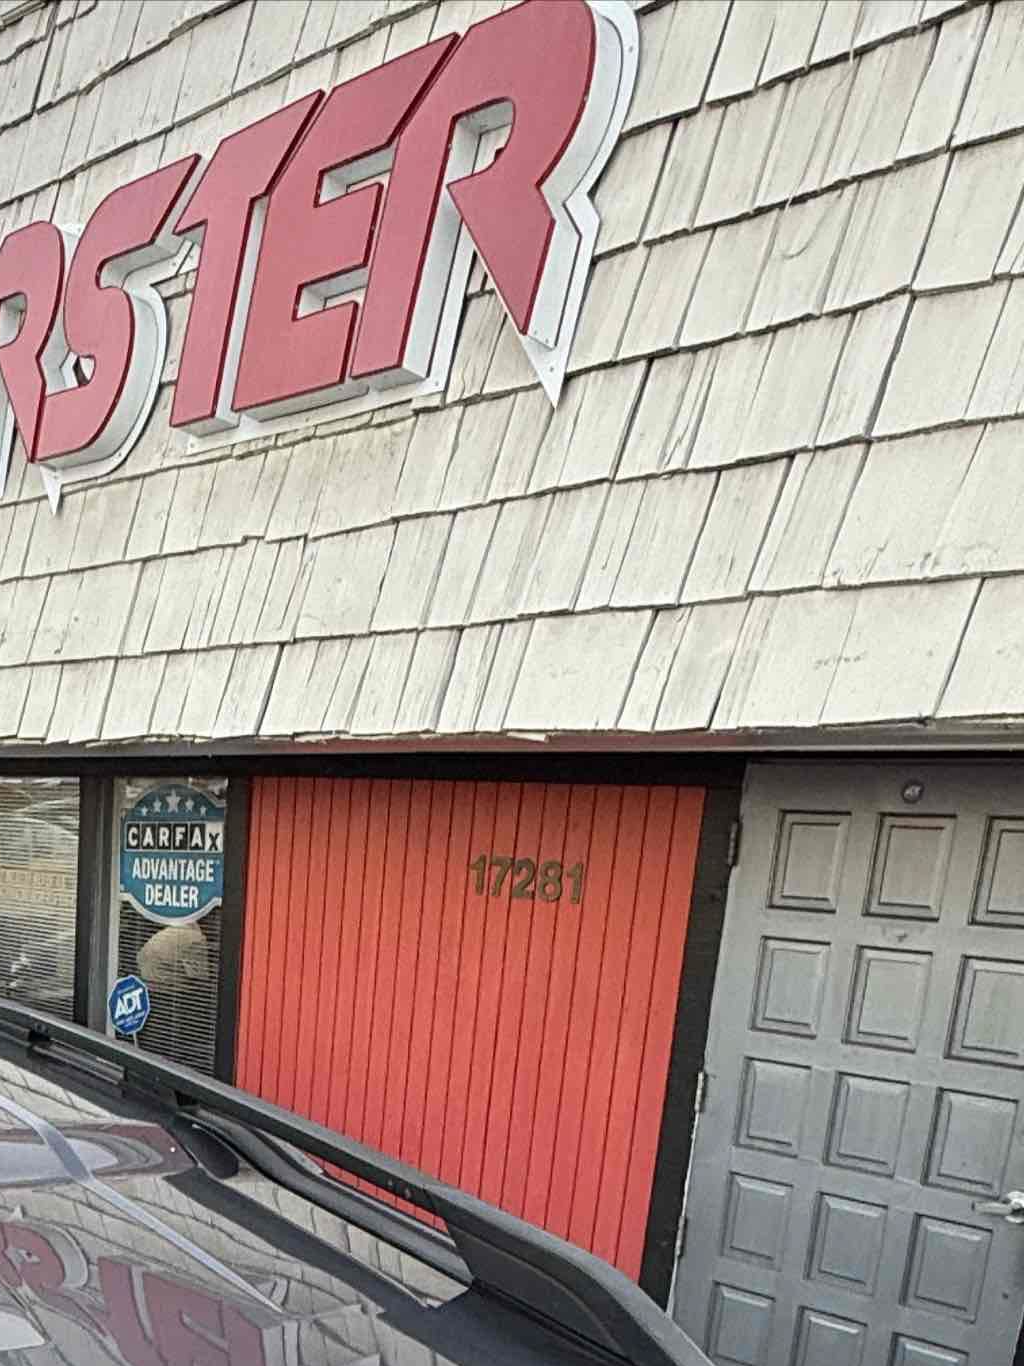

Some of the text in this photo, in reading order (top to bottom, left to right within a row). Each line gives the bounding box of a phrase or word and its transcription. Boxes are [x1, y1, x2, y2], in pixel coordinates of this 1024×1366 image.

[127, 827, 224, 852] CARFAX
[132, 857, 215, 882] ADVANTAGE
[470, 854, 584, 905] 17281
[145, 884, 199, 908] DEALER
[114, 987, 144, 1019] ADT
